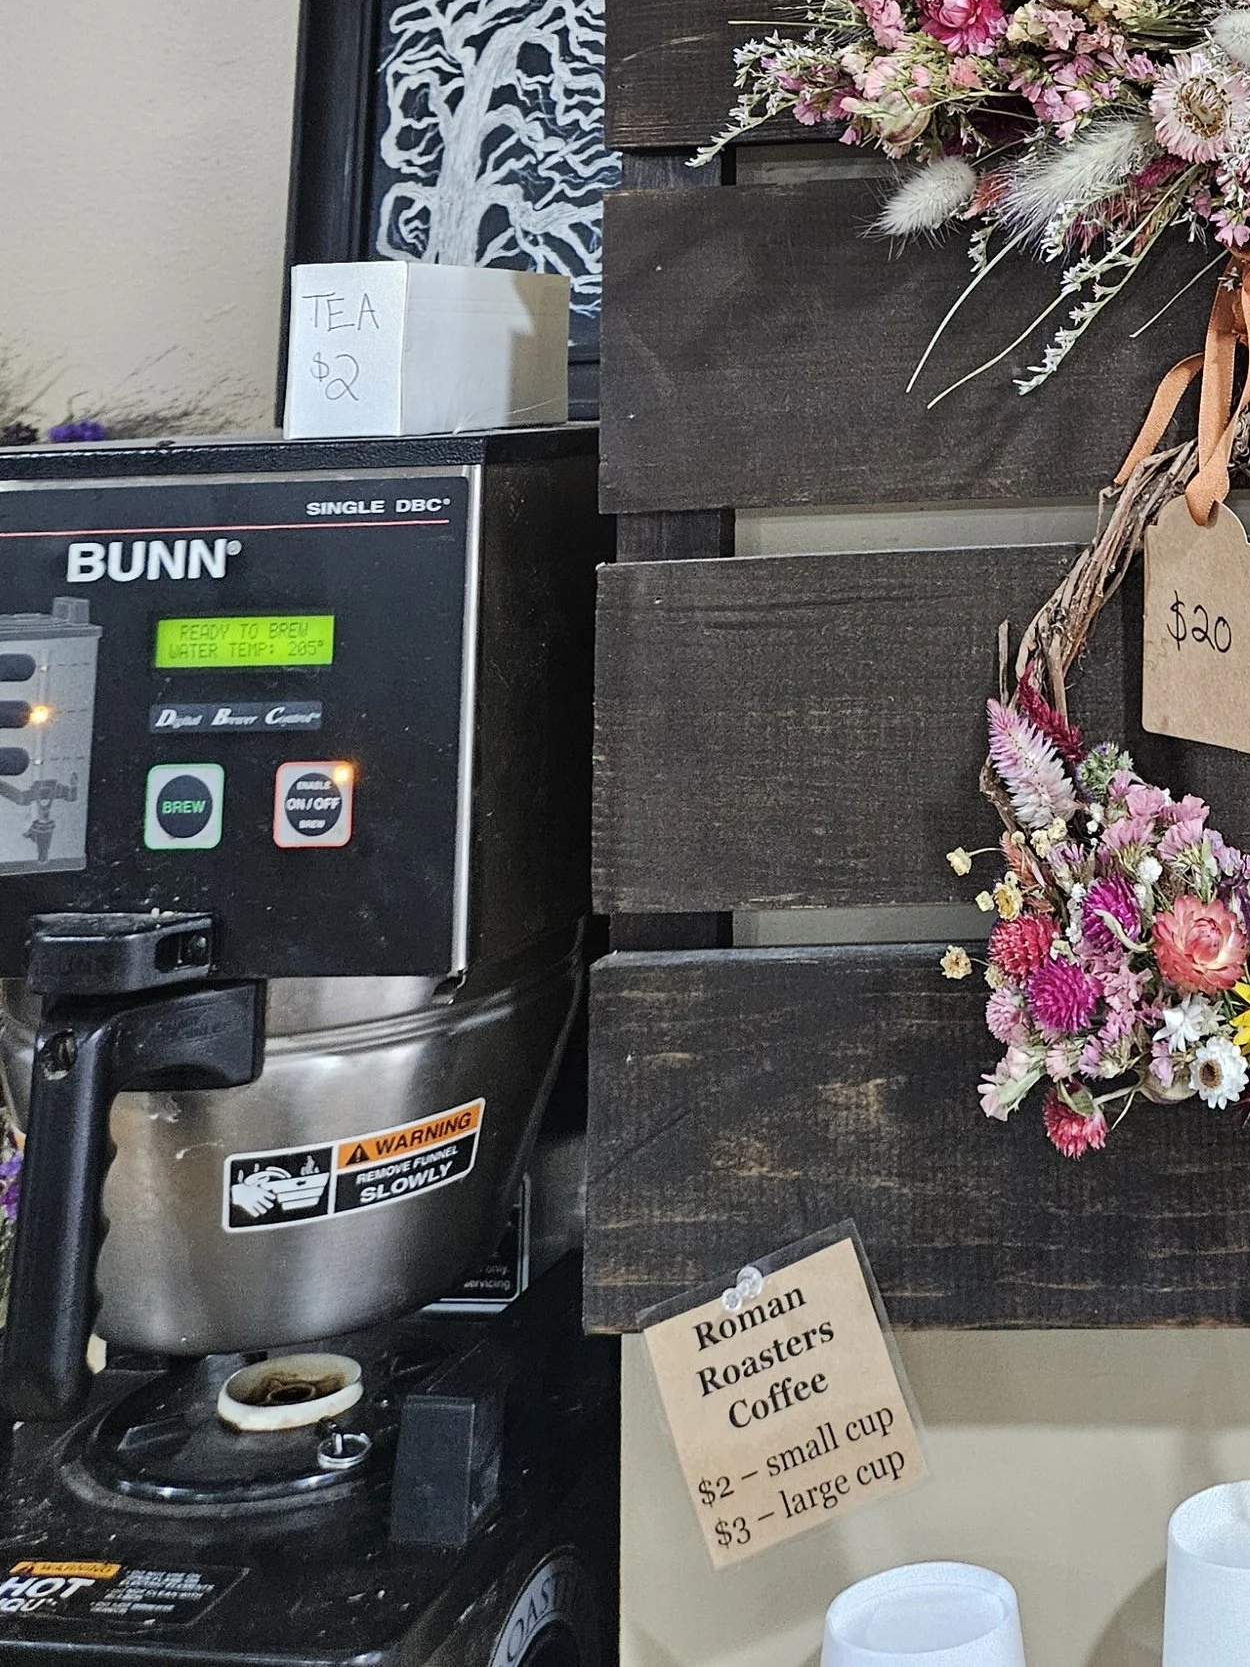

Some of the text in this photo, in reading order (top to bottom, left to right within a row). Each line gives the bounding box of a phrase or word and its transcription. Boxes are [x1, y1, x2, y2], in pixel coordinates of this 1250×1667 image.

[302, 292, 380, 332] TEA
[310, 352, 360, 401] $2
[306, 500, 385, 516] SINGLE
[180, 621, 309, 641] READY TO BREW
[1166, 590, 1232, 653] $20
[169, 643, 218, 660] WATER
[229, 642, 275, 659] TEMP:
[162, 800, 206, 814] BREW
[375, 1112, 472, 1155] WARNING
[356, 1145, 459, 1185] REMOVE FUNNEL
[360, 1161, 453, 1203] SLOWLY
[692, 1287, 808, 1351] Roman
[695, 1318, 836, 1397] Roasters
[728, 1370, 829, 1430] Coffee
[698, 1476, 736, 1507] $2
[766, 1422, 839, 1478] small
[845, 1406, 895, 1443] cup
[714, 1516, 752, 1549] $3
[780, 1474, 852, 1519] large
[856, 1448, 906, 1487] cup
[0, 1577, 96, 1598] HOT
